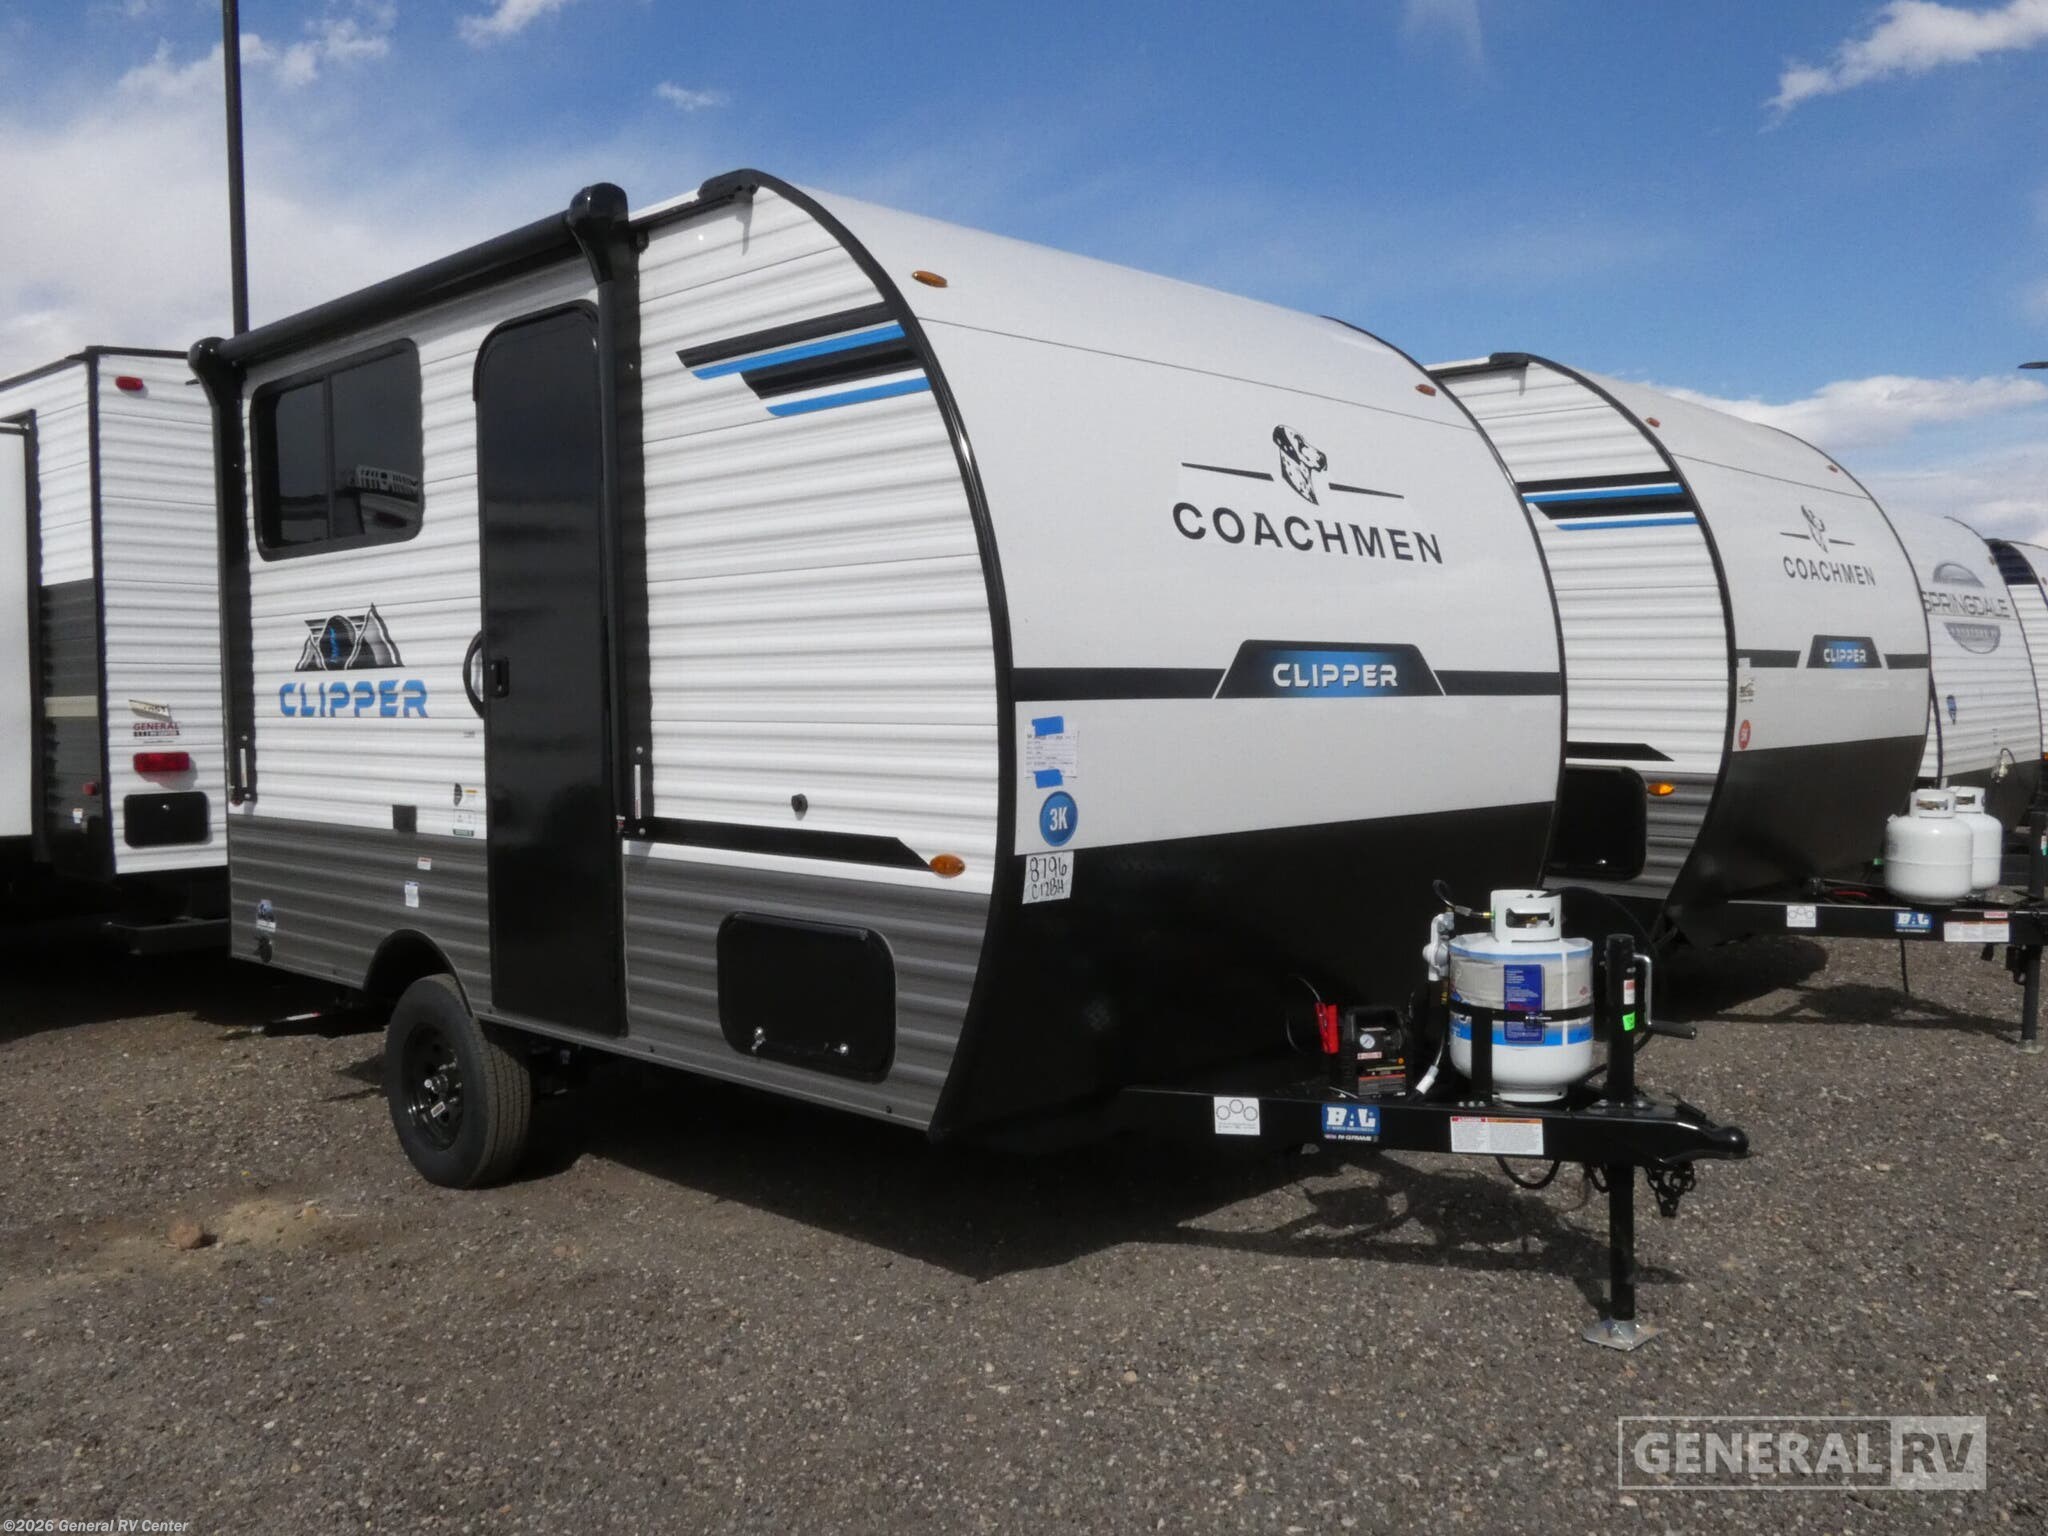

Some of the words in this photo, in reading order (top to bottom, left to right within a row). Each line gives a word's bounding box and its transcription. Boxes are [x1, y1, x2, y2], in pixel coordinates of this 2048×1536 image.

[1172, 502, 1443, 564] COACHMEN
[1783, 556, 1876, 586] COACHMEN
[1922, 590, 2011, 618] SPRINGDALE
[1823, 648, 1867, 663] CLIPPER
[1272, 663, 1399, 688] CLIPPER
[279, 679, 429, 718] CLIPPER
[133, 722, 179, 731] GENERAL
[1049, 806, 1068, 831] 3K
[1029, 856, 1067, 882] 8796
[1327, 1106, 1376, 1127] BAL
